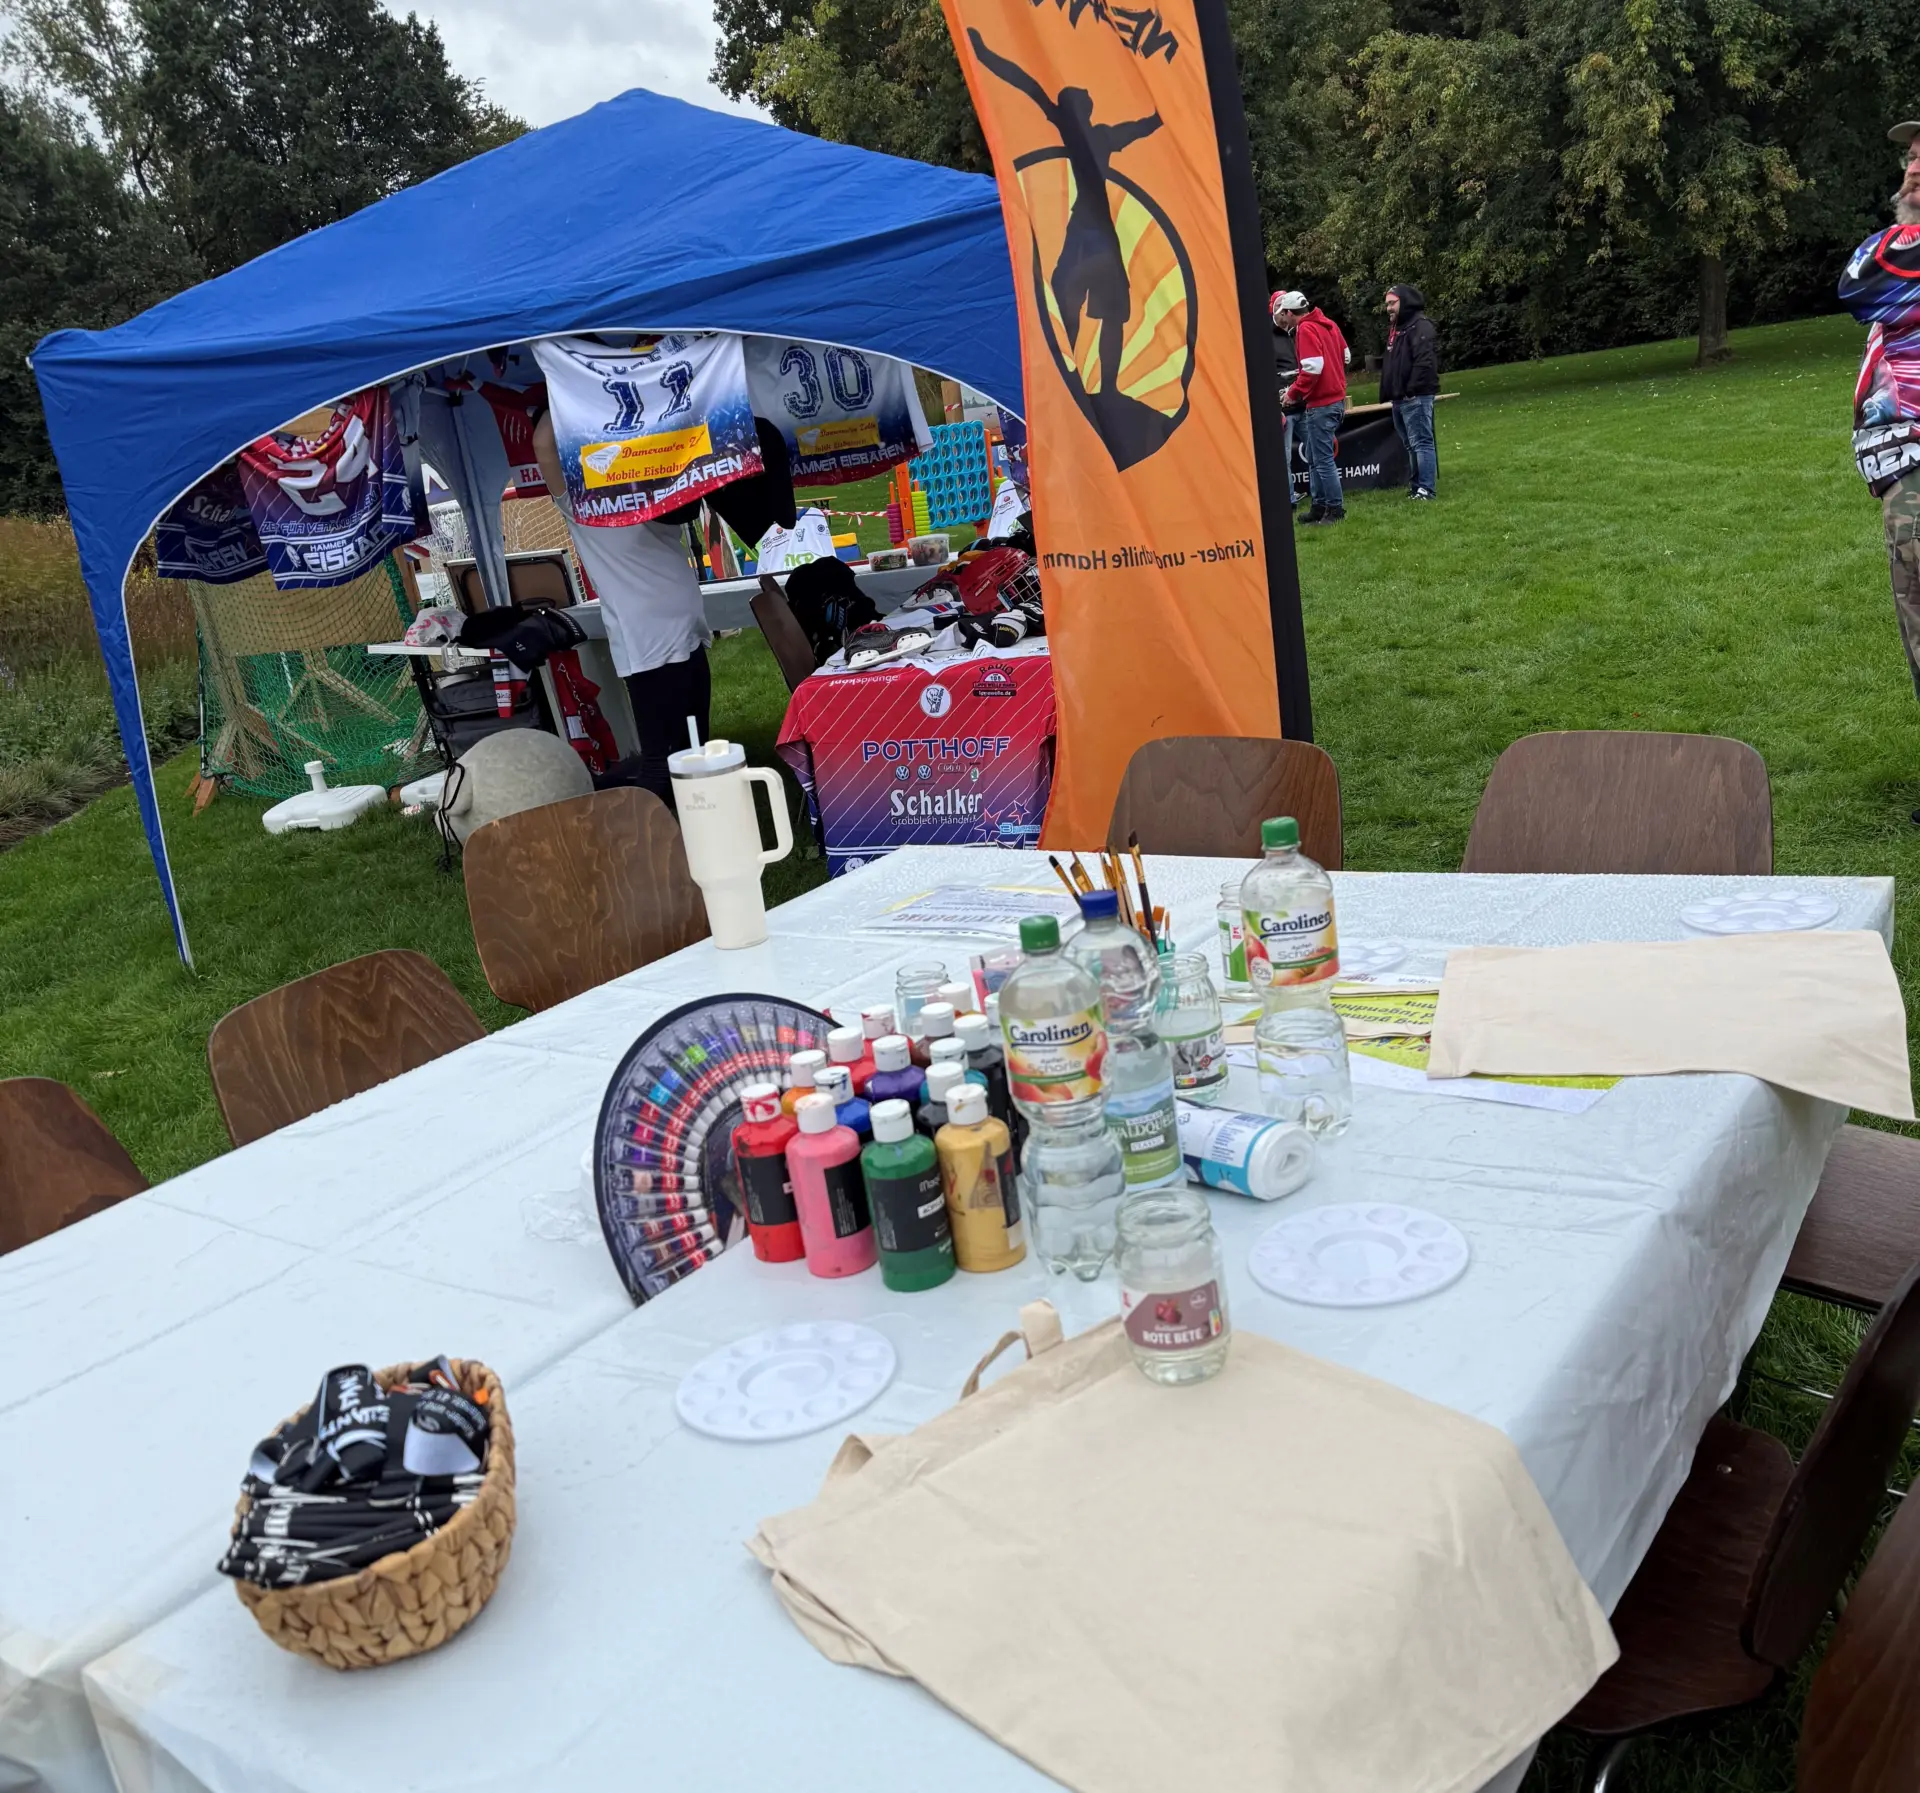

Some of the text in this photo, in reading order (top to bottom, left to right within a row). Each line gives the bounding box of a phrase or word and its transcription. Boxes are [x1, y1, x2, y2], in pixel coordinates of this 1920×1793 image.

[780, 345, 874, 420] 30
[602, 359, 693, 436] 11
[790, 441, 905, 476] AMMER EISBÄREN
[605, 466, 641, 483] Mobile
[1345, 463, 1380, 478] HAMM
[573, 490, 649, 519] HAMMER
[281, 520, 305, 534] FÜR
[310, 539, 348, 552] HAMMER
[978, 663, 1015, 675] RADIO
[862, 736, 1011, 763] POTTHOFF
[890, 788, 983, 817] Schalker
[1260, 911, 1331, 933] Carolinen
[1010, 1021, 1090, 1043] Carolinen
[1142, 1330, 1172, 1345] ROTE
[1174, 1327, 1202, 1345] BETE
